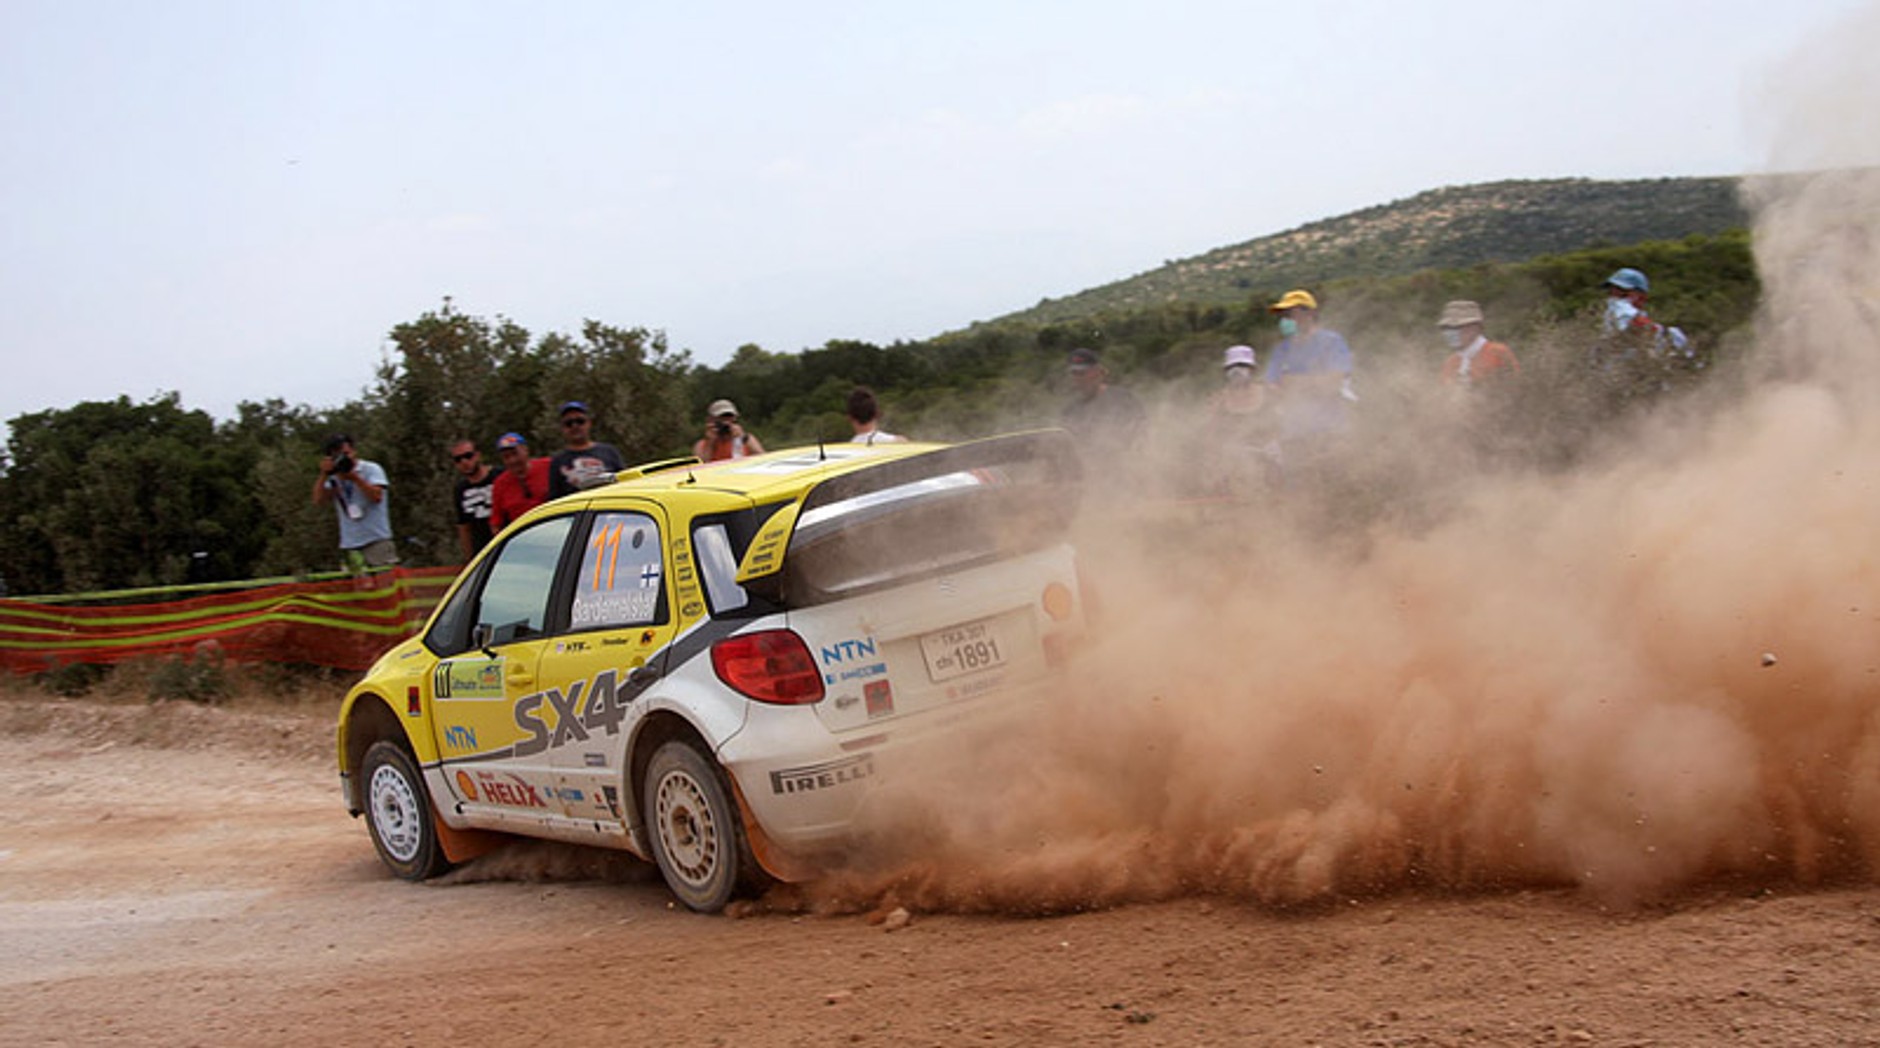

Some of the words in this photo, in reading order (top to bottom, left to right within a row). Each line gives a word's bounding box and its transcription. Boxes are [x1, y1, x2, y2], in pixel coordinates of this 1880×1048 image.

[592, 521, 625, 592] 11
[822, 636, 876, 666] NTN
[955, 638, 1000, 671] 1891
[514, 669, 628, 758] SX4
[444, 726, 478, 750] NTN
[768, 753, 875, 795] PIRELLI
[479, 779, 548, 808] HELIX
